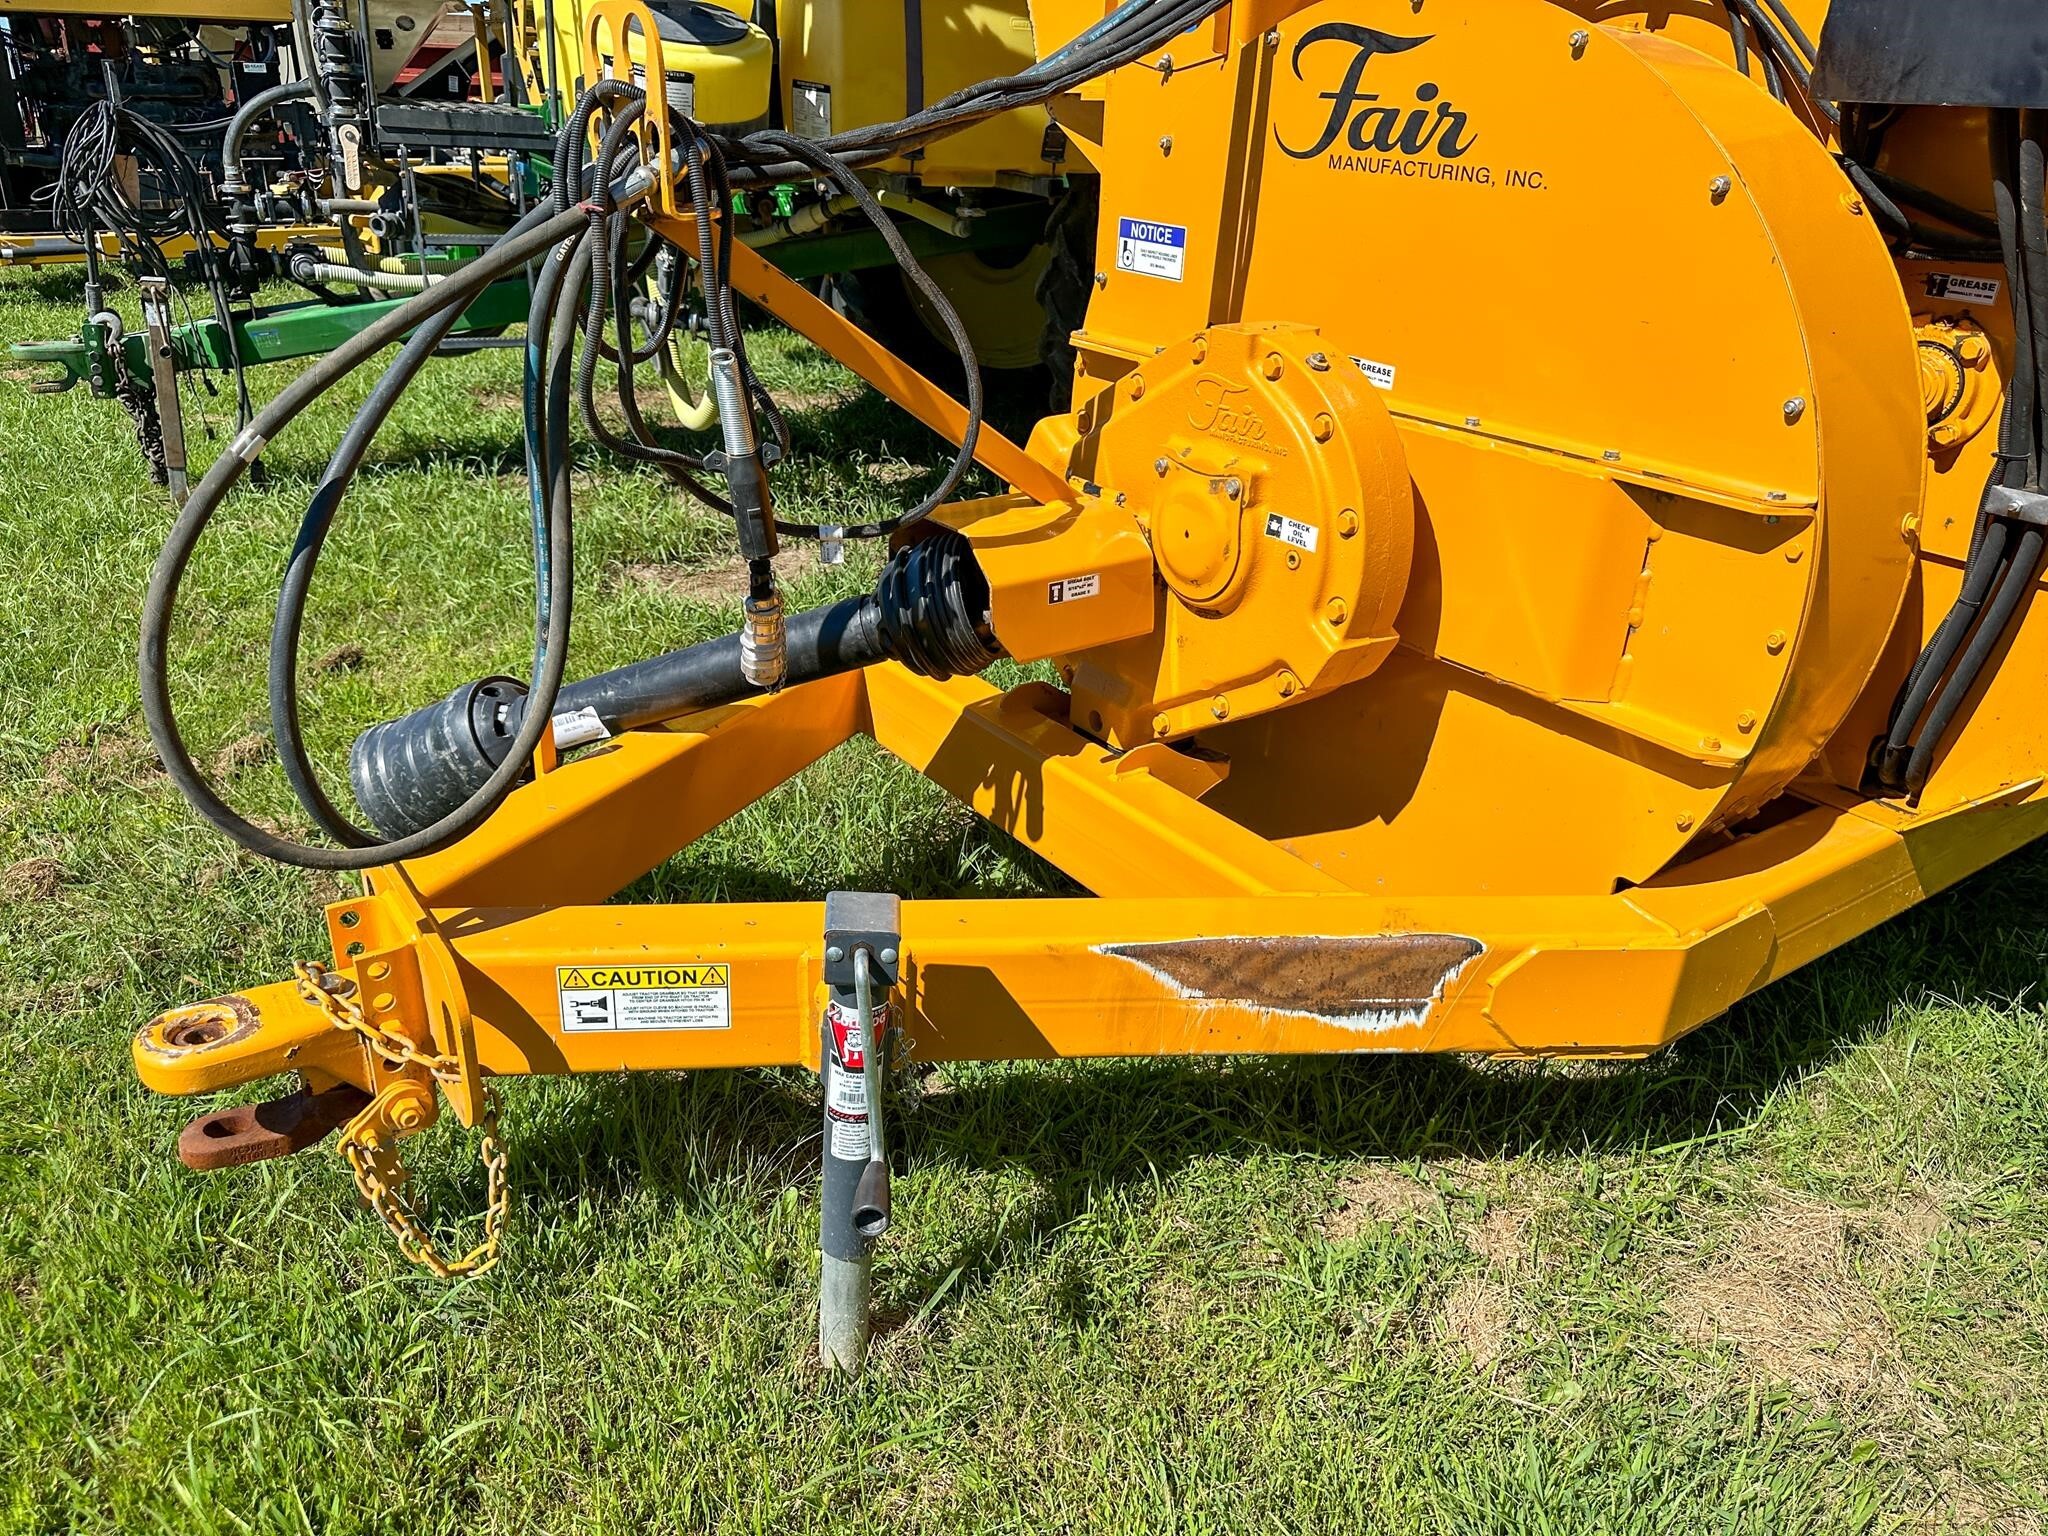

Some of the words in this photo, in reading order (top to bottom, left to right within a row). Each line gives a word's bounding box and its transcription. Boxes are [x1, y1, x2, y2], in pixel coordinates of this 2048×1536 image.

[1274, 22, 1478, 159] Fair
[1328, 154, 1495, 187] MANUFACTURING,
[1505, 169, 1548, 190] INC.
[1131, 222, 1172, 244] NOTICE
[556, 234, 576, 262] GATES
[1950, 278, 1997, 292] GREASE
[1361, 363, 1392, 377] GREASE
[1288, 520, 1311, 533] CHECK
[1293, 529, 1304, 539] OIL
[1287, 535, 1307, 547] LEVEL
[592, 970, 697, 986] CAUTION
